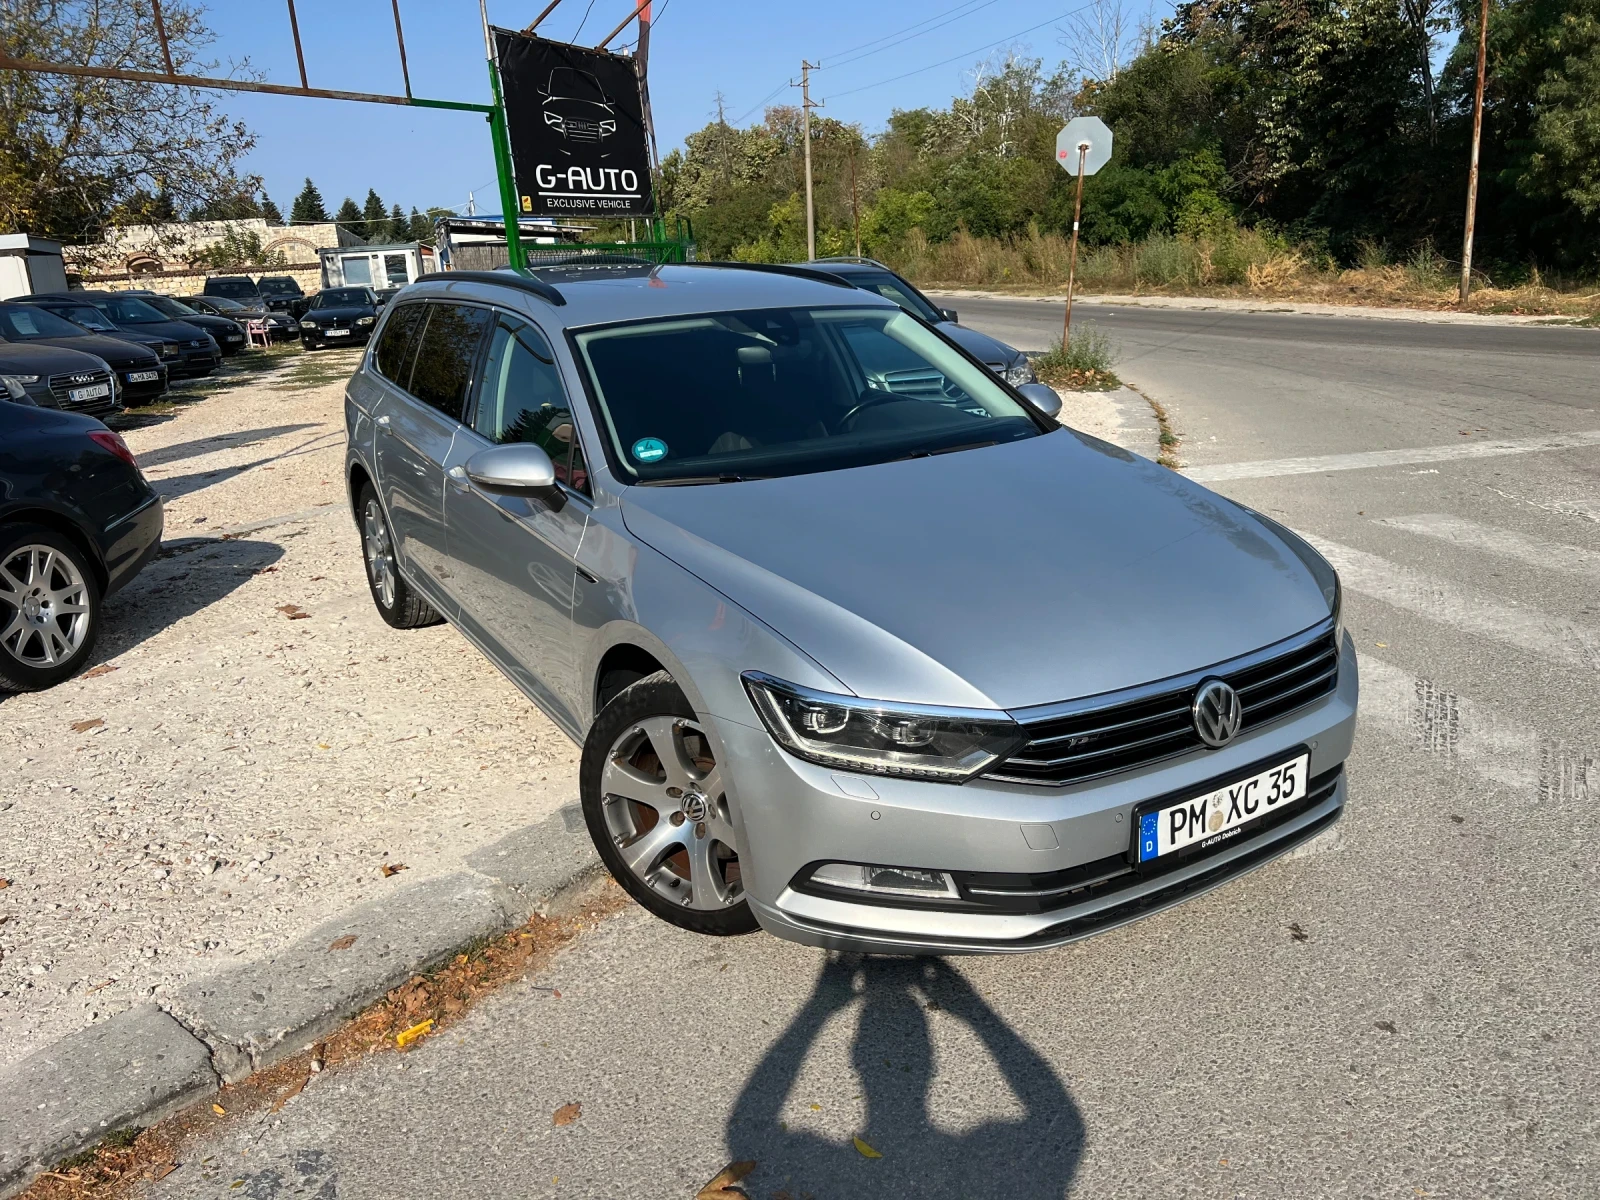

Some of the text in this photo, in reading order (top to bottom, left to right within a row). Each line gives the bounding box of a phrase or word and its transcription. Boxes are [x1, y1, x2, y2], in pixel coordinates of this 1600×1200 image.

[535, 164, 638, 191] G-AUTO
[546, 198, 631, 209] EXCLUSIVE VEHICLE
[1169, 762, 1298, 846] PM XC 35
[1146, 840, 1154, 852] D
[1201, 827, 1242, 848] G-AUTO Dobrich
